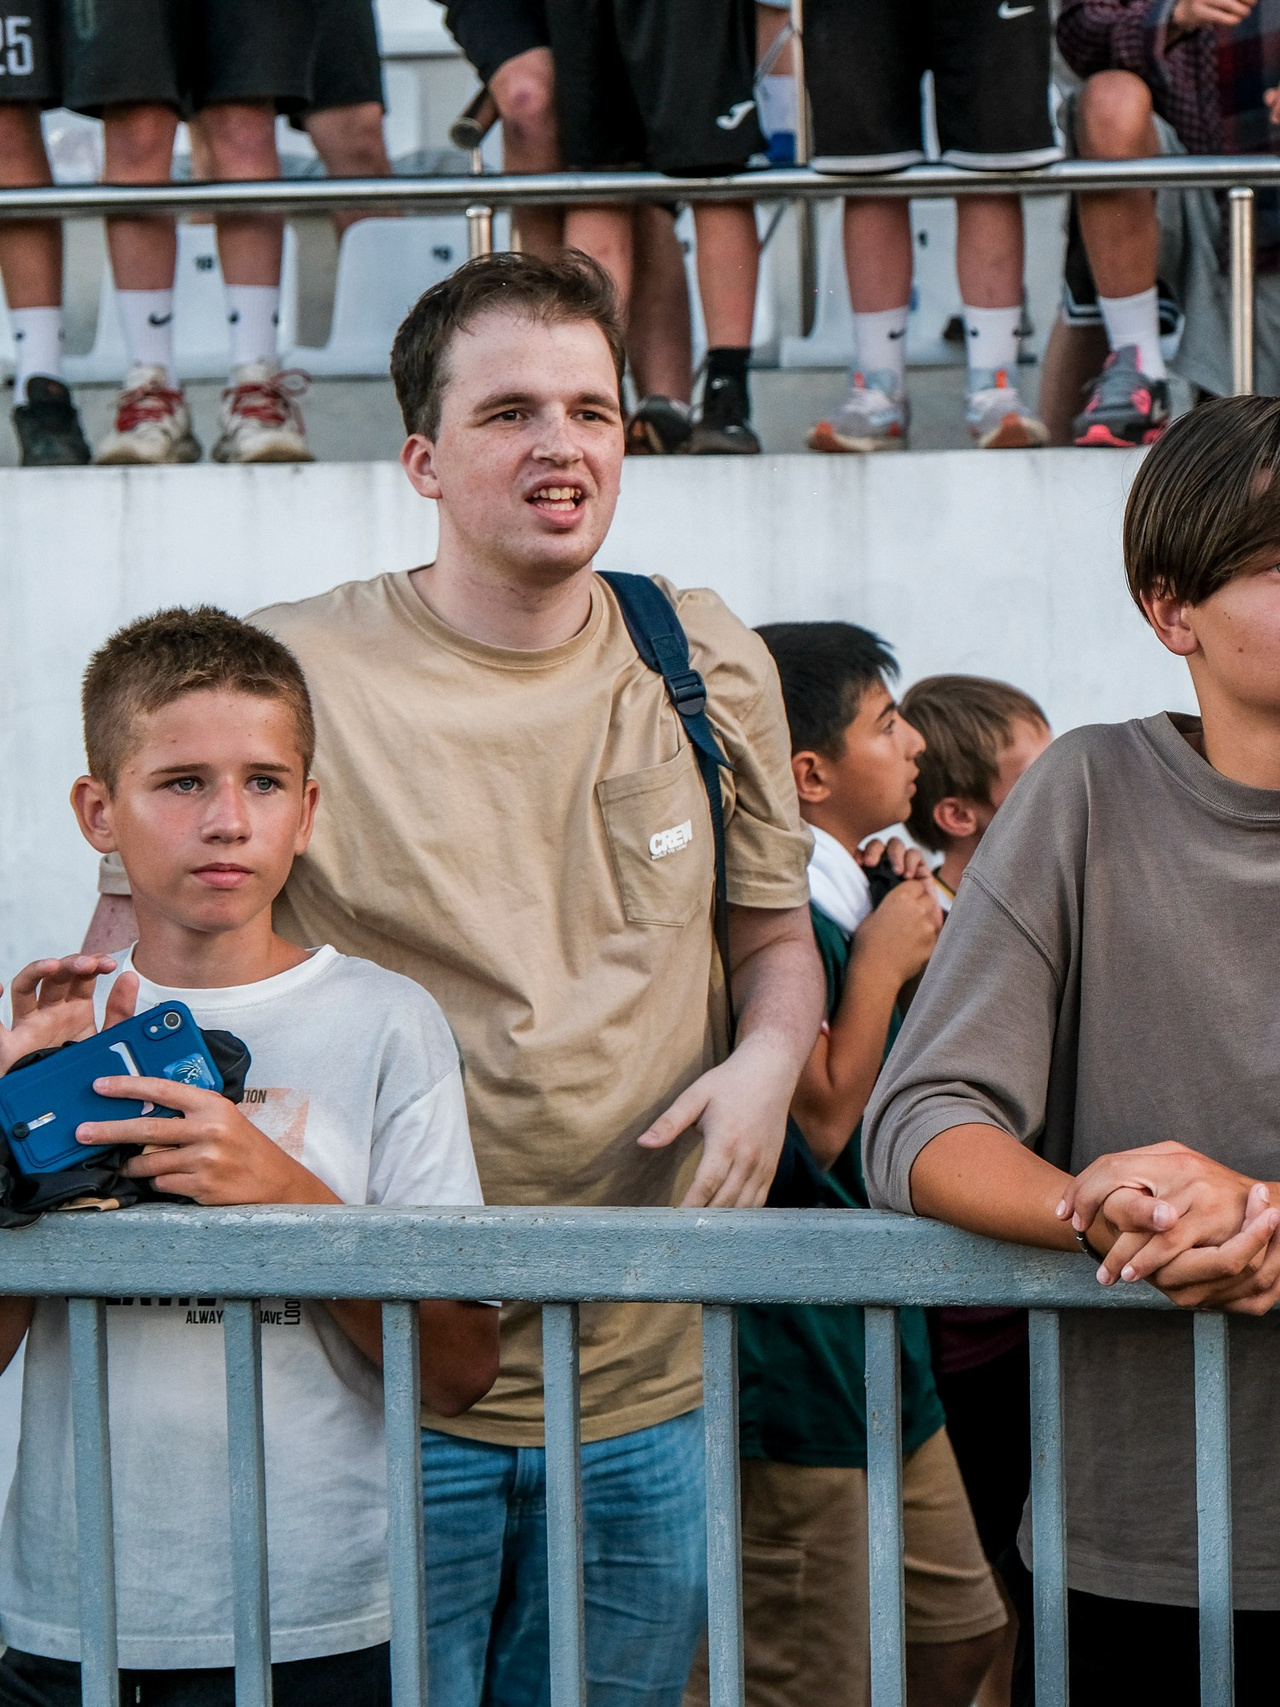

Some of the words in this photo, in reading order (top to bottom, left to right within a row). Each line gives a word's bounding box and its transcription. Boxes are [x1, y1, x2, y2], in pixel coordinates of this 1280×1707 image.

[0, 15, 34, 76] 5
[649, 819, 693, 856] CREW
[186, 1310, 224, 1324] ALWAY
[284, 1298, 301, 1325] LOO
